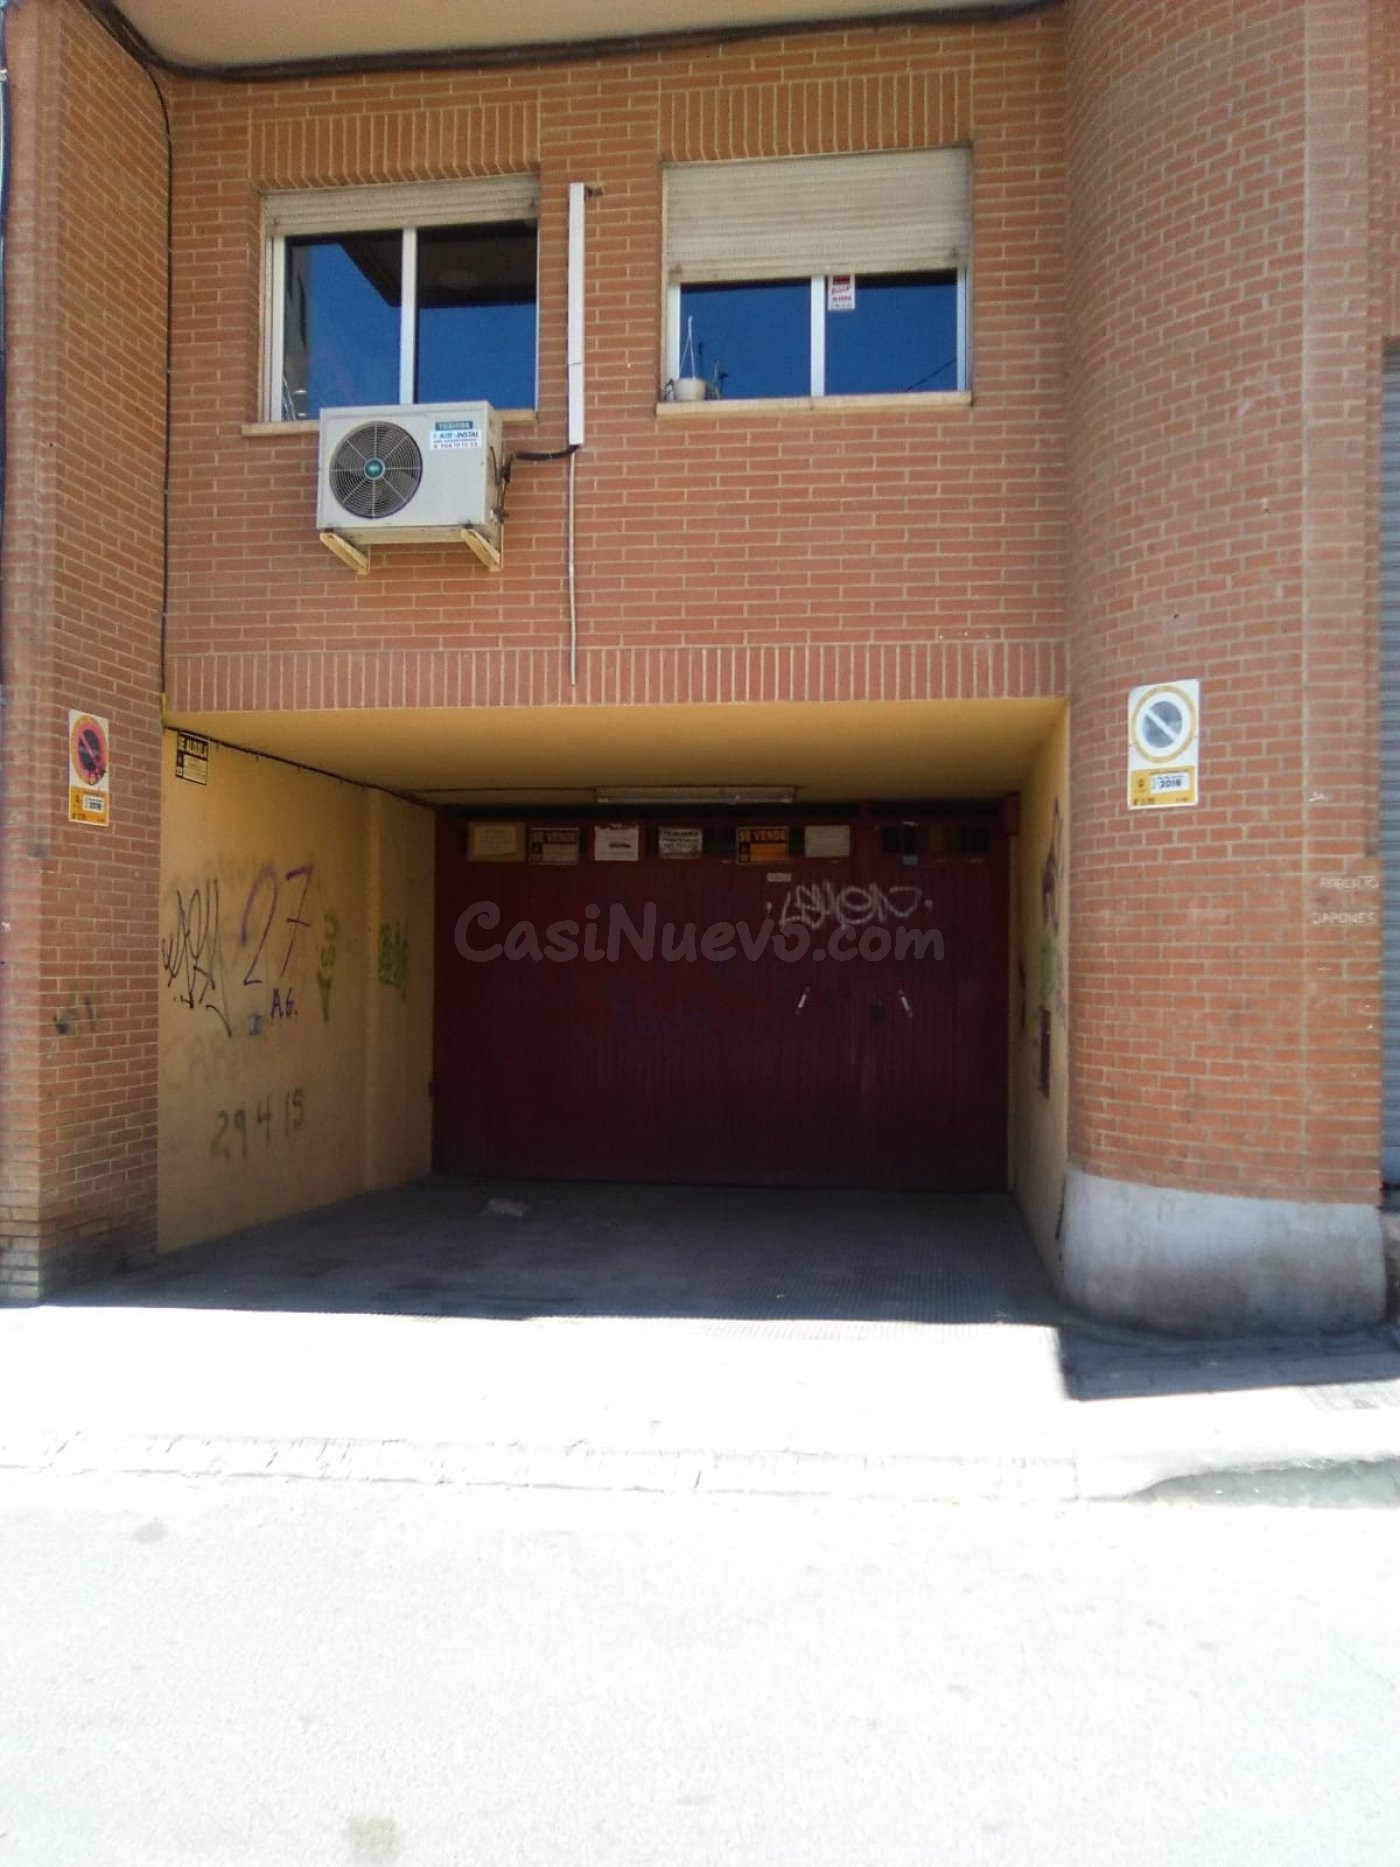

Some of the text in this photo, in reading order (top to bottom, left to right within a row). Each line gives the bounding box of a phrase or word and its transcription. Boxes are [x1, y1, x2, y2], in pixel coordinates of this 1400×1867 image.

[740, 829, 786, 842] SE VENDE
[210, 1108, 247, 1159] 29
